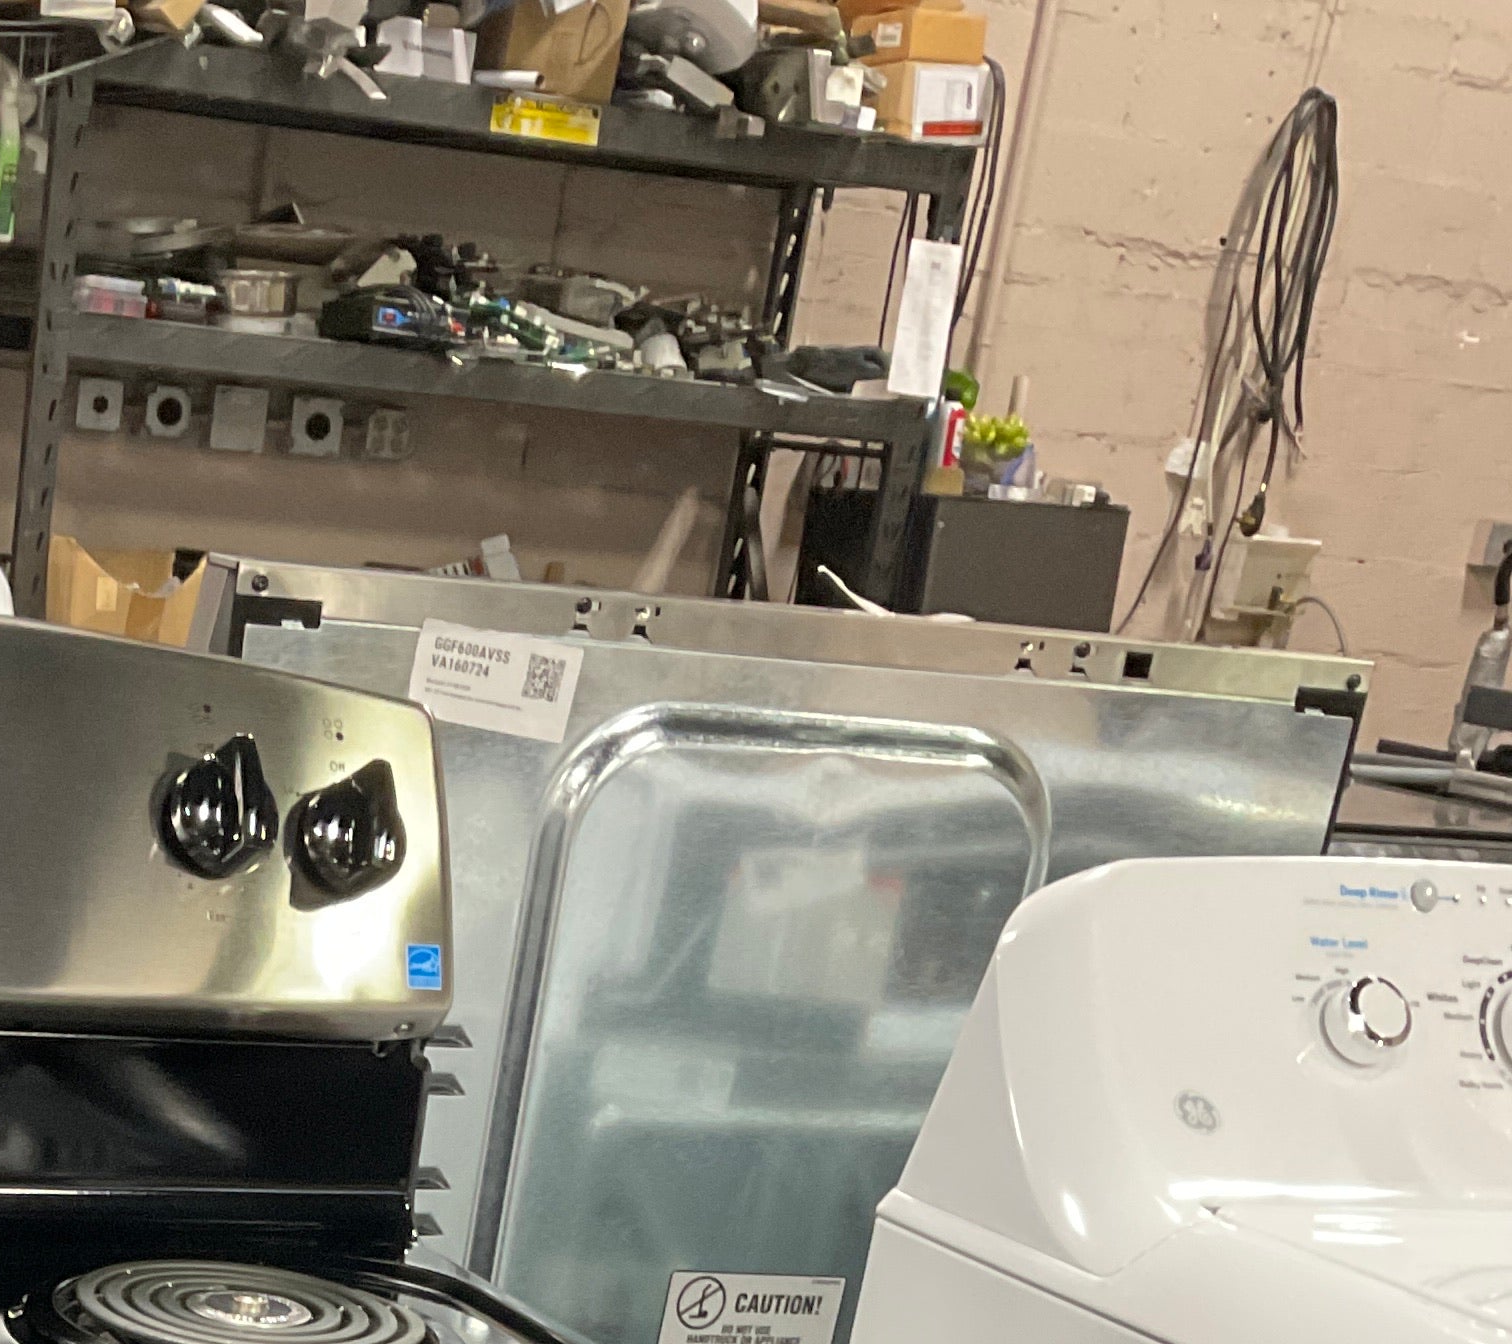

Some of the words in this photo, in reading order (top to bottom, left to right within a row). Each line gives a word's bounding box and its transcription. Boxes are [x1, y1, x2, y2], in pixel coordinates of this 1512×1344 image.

[434, 636, 511, 664] GGF600AVSS
[431, 654, 490, 678] VA160724
[1340, 884, 1367, 898] Deep
[1369, 886, 1398, 899] Rinse
[734, 1292, 823, 1316] CAUTION!
